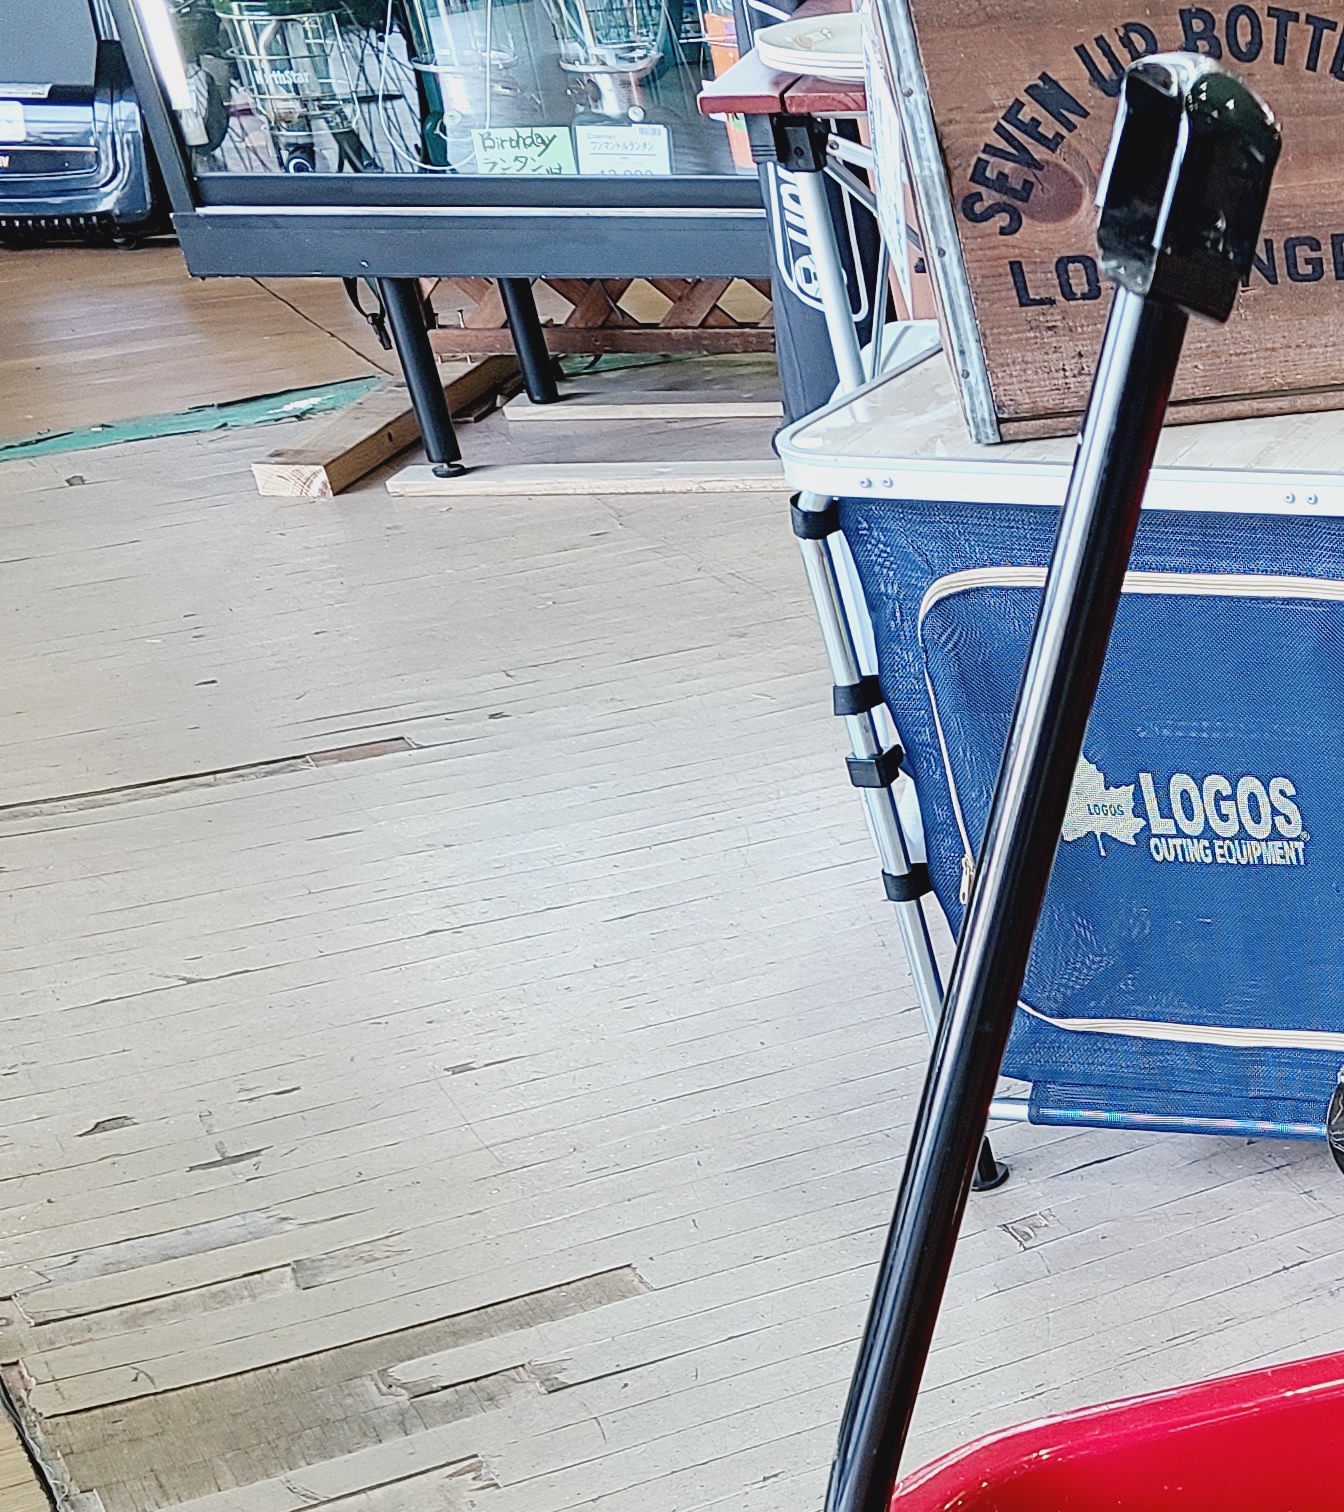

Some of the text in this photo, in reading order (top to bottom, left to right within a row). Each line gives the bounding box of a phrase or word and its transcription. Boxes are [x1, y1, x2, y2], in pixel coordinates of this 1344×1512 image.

[478, 127, 557, 157] Birthday
[961, 72, 1091, 236] SEVEN
[1009, 254, 1100, 308] LO
[1087, 803, 1125, 816] LOGOS
[1138, 772, 1302, 839] LOGOS
[1150, 838, 1306, 866] OUTING EQUIPMENT
